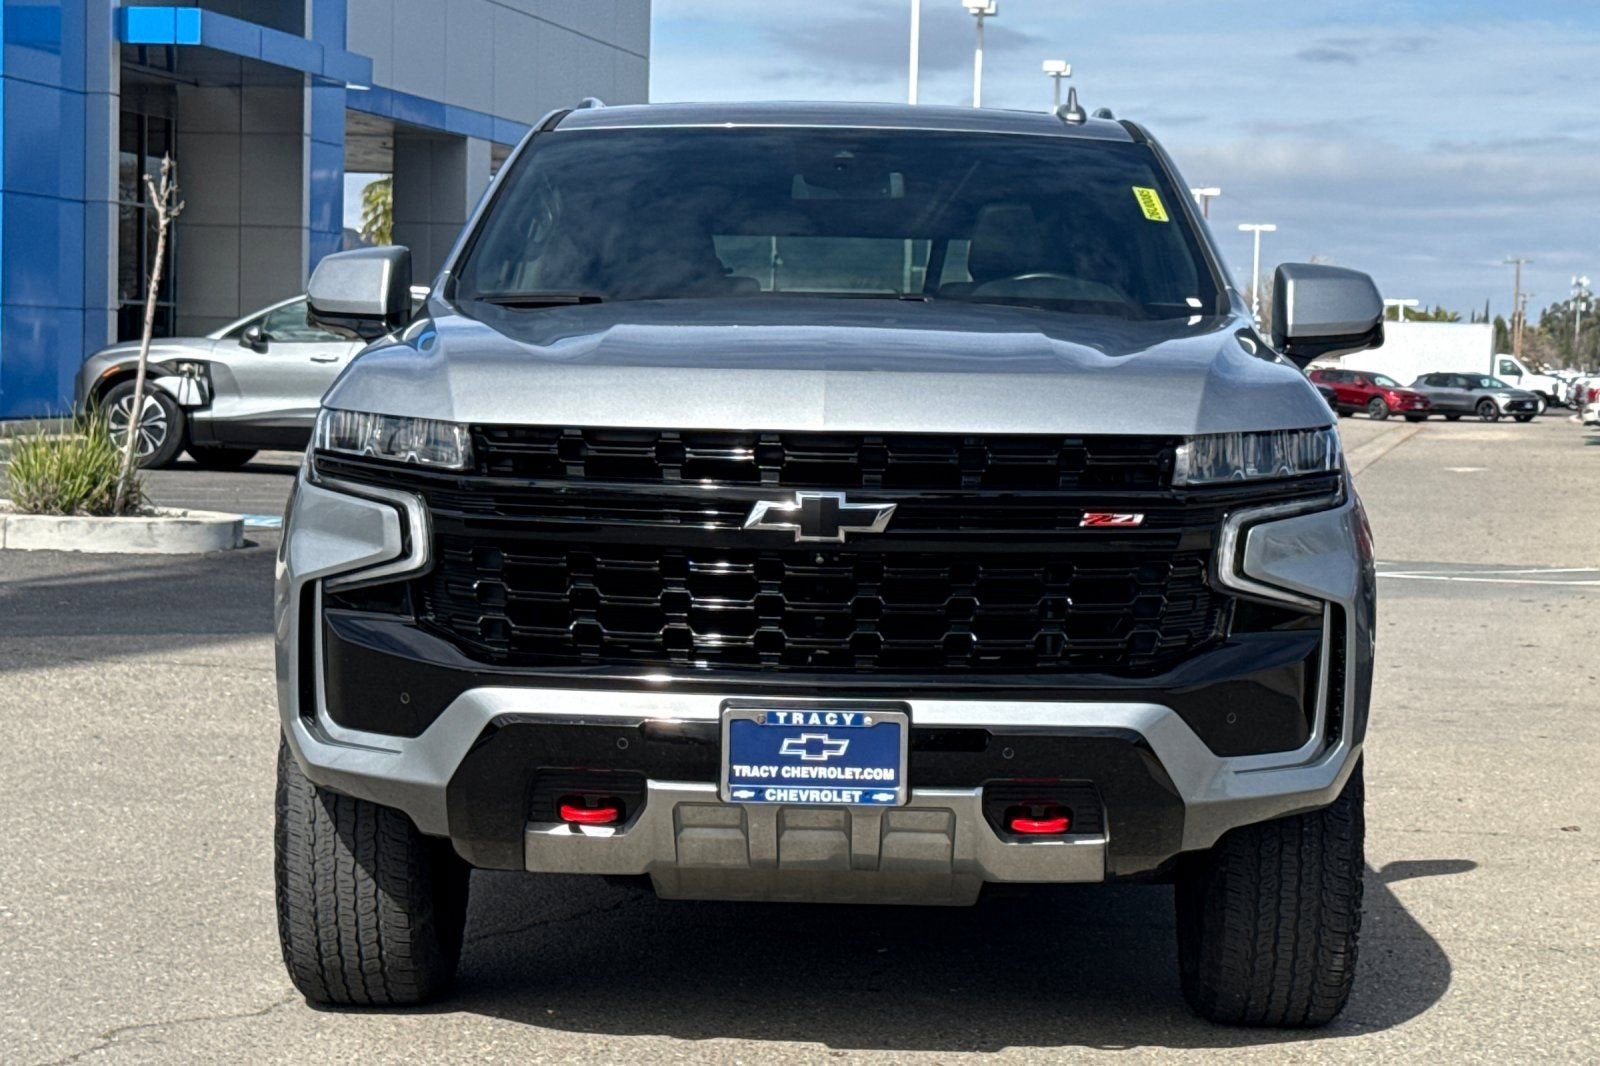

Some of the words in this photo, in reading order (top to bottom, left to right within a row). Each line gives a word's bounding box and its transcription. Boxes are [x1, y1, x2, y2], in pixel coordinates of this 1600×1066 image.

[1079, 512, 1144, 527] Z71
[776, 712, 855, 725] TRACY
[733, 765, 778, 778] TRACY
[781, 766, 895, 780] CHEVROLET.COM
[764, 788, 863, 803] CHEVROLET
